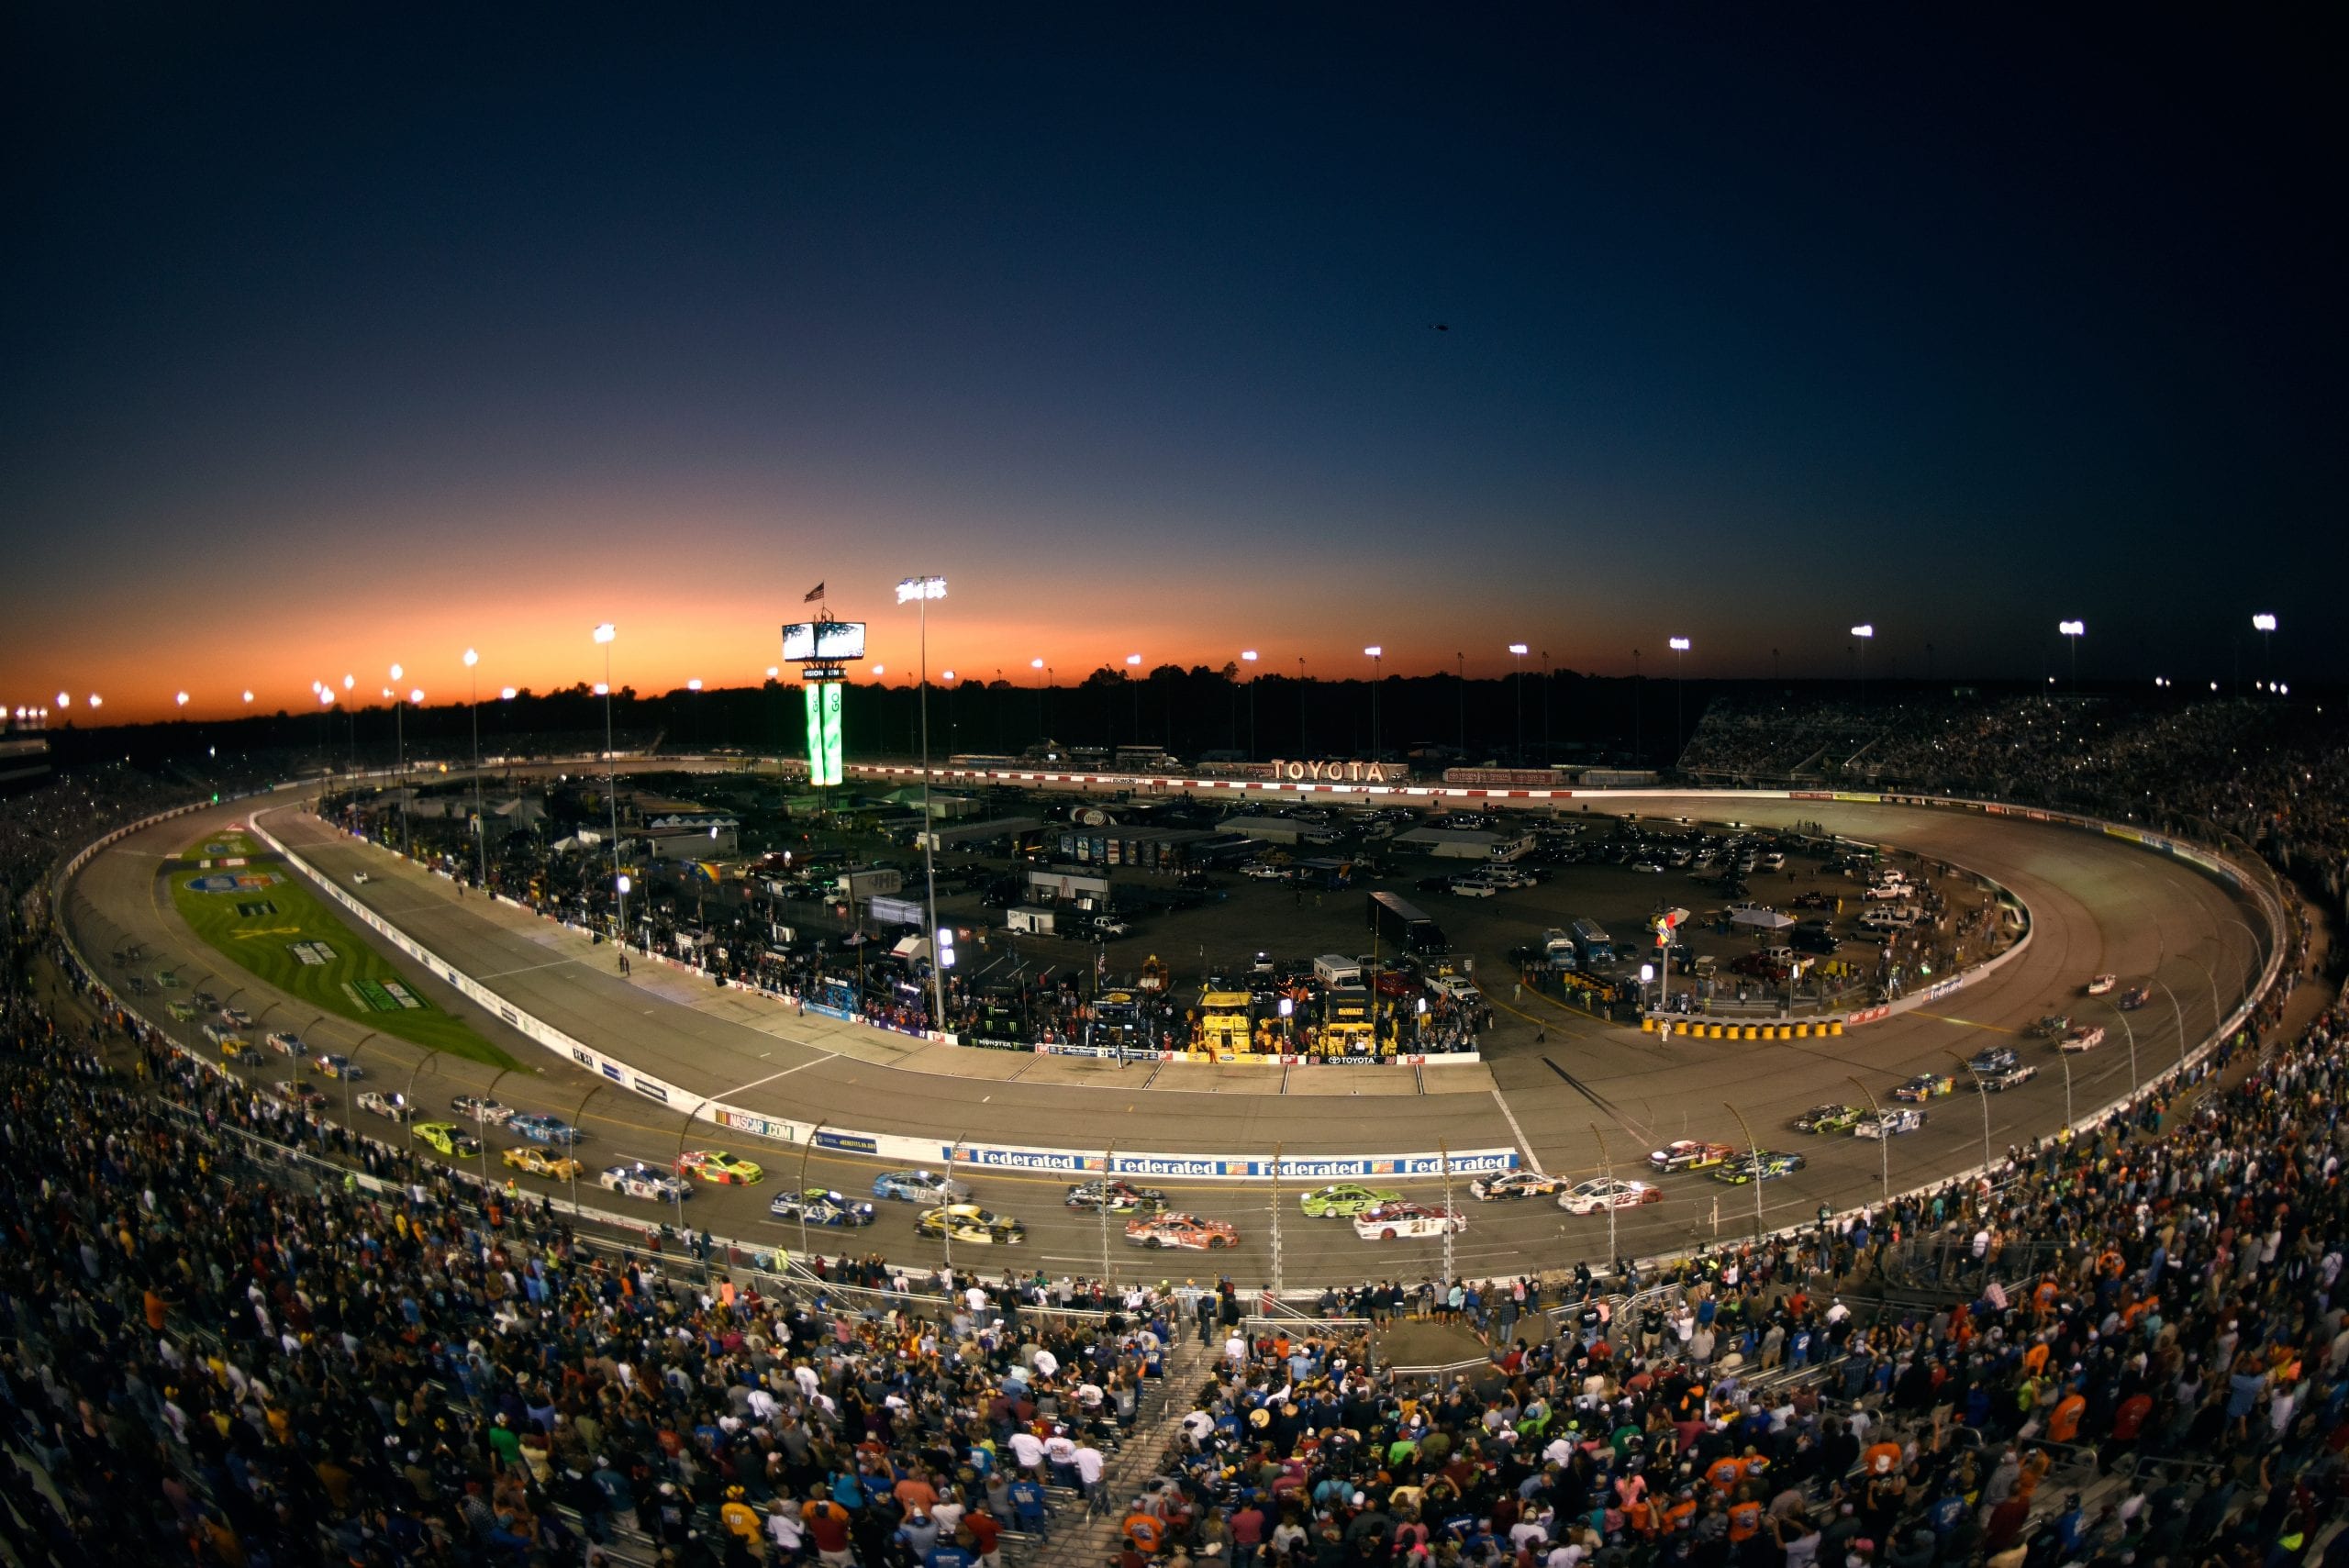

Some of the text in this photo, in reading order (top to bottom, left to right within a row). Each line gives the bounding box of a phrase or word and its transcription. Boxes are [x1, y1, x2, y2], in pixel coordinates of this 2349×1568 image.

[831, 693, 840, 712] GO
[1272, 759, 1389, 782] TOYOTA
[1931, 978, 1964, 1000] Federated
[977, 1149, 1075, 1169] Federated
[1405, 1154, 1509, 1173] Federated
[1113, 1158, 1217, 1174] Federated
[1258, 1161, 1364, 1175] Federated
[1768, 1161, 1785, 1174] 77
[914, 1188, 928, 1199] 10
[1522, 1184, 1538, 1195] 14
[1615, 1193, 1632, 1205] 22
[812, 1207, 828, 1220] 48
[1353, 1202, 1365, 1212] 2
[1411, 1221, 1426, 1233] 21
[1177, 1232, 1193, 1244] 19
